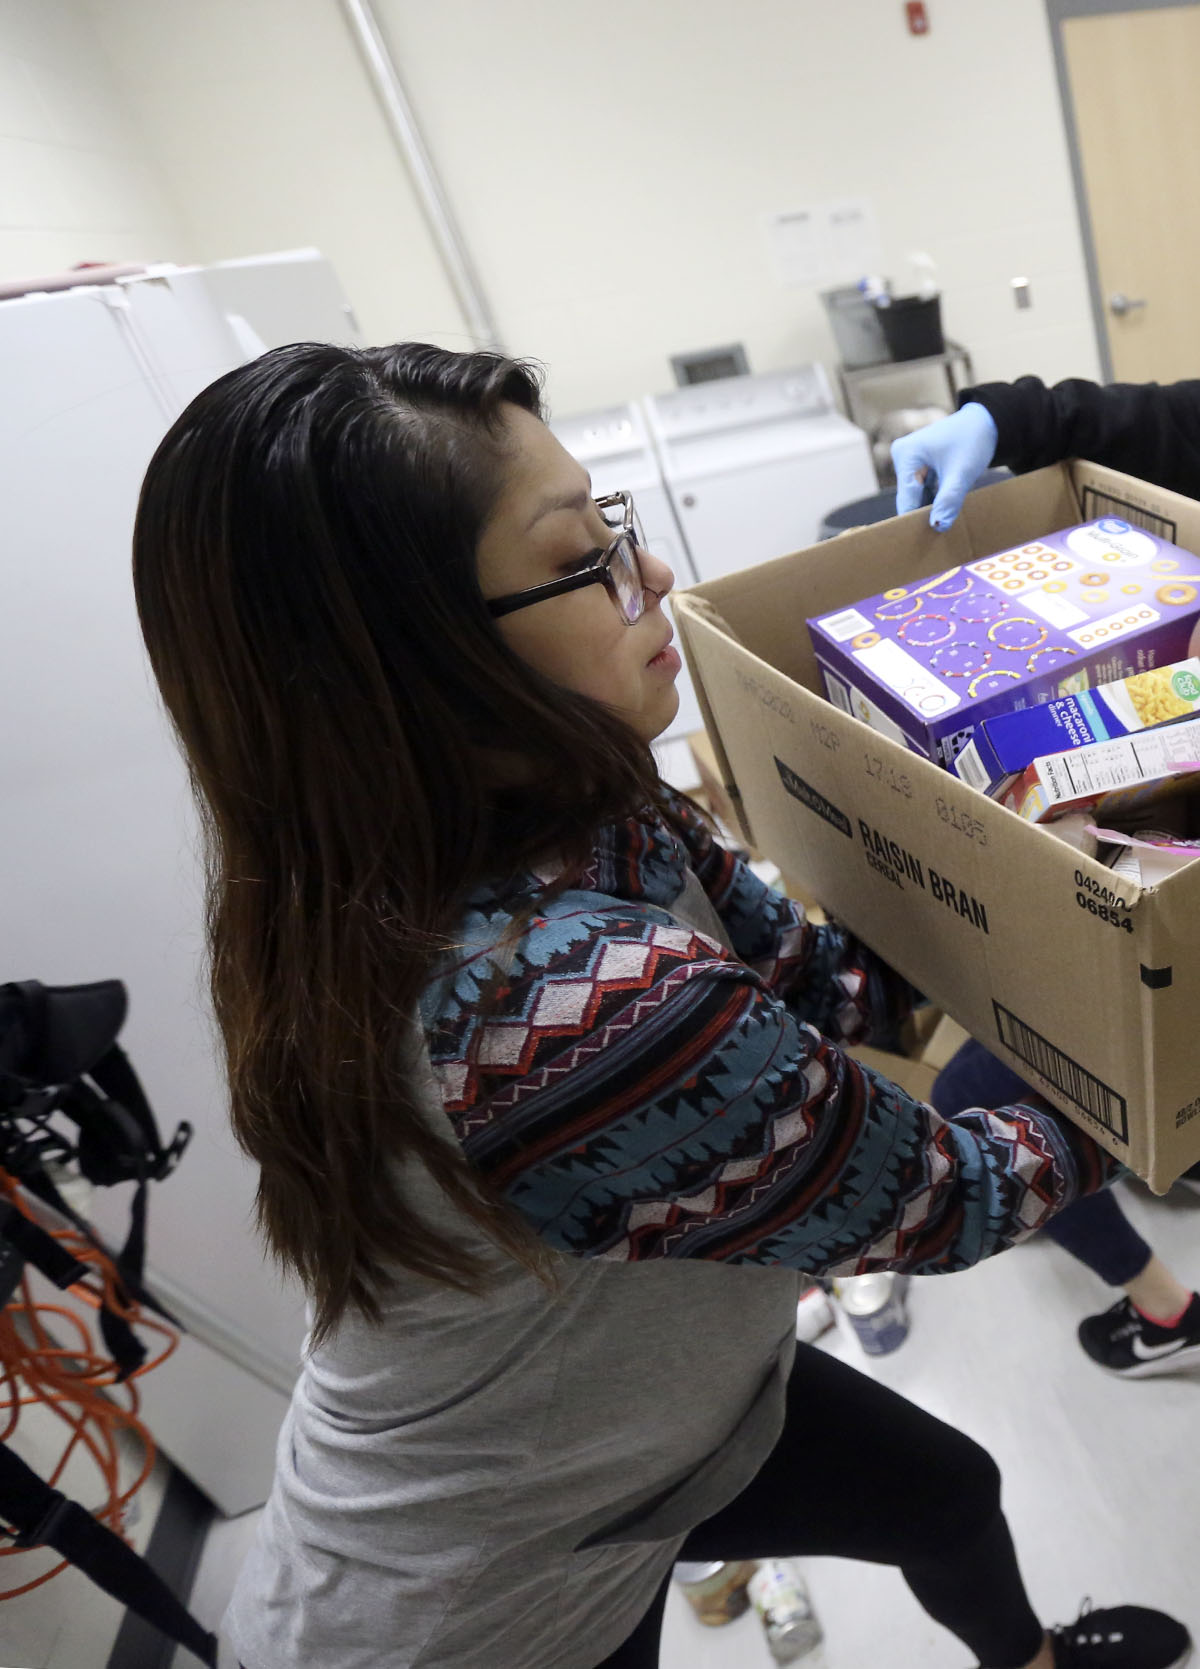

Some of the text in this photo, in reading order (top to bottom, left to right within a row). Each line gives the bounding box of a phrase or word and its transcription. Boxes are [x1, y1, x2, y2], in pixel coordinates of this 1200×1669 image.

[1048, 703, 1063, 727] dinner
[1055, 701, 1081, 746] & cheese
[1065, 697, 1094, 743] macaroni
[858, 818, 990, 935] RAISIN BRAN
[866, 851, 905, 891] CEREAL
[1075, 891, 1135, 934] 06854
